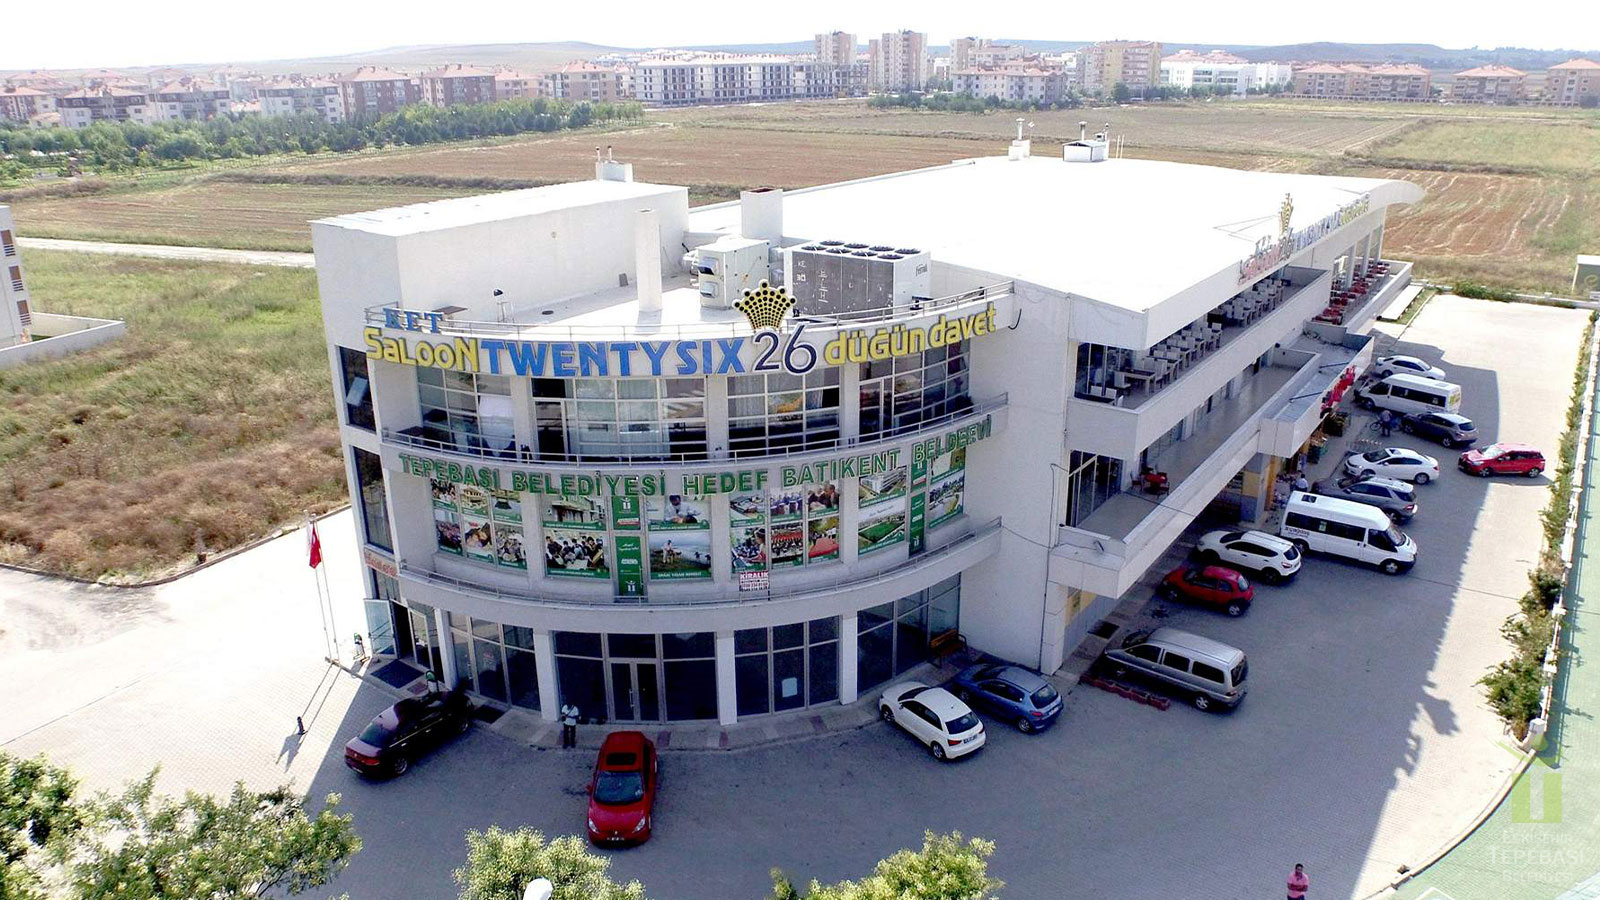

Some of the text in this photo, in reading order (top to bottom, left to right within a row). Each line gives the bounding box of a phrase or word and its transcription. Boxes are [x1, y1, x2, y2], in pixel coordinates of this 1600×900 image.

[481, 340, 745, 375] TWENTYSIX
[751, 323, 818, 376] 26
[928, 301, 997, 348] davet
[512, 469, 666, 496] BELEDİYESİ
[682, 469, 769, 496] HEDEF
[782, 448, 902, 488] BATIKENT
